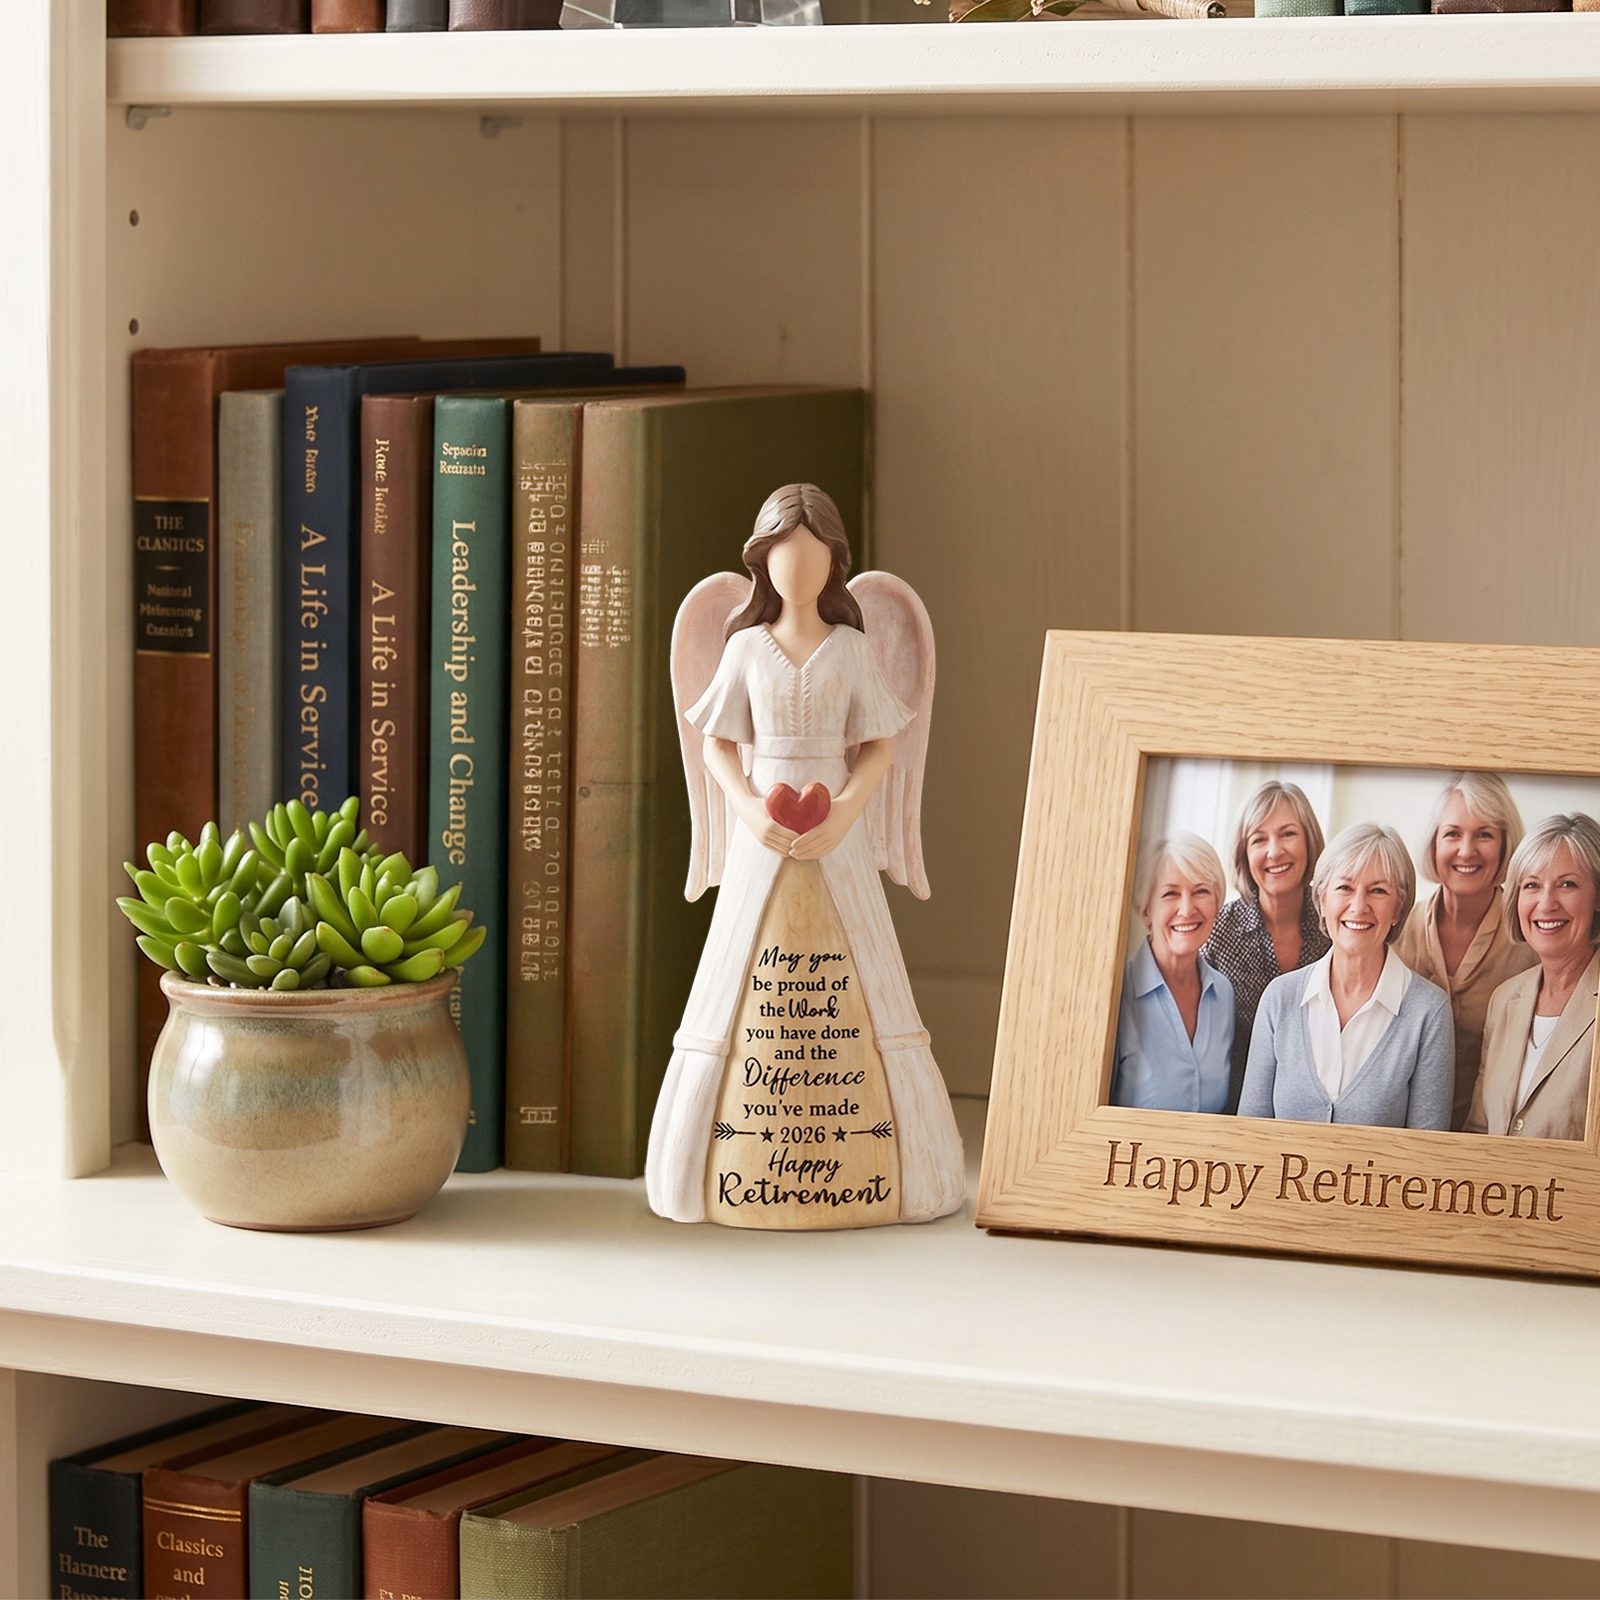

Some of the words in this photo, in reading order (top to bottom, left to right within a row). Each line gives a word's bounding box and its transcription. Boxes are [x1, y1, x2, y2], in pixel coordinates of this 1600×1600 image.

[154, 515, 184, 530] THE
[300, 523, 327, 551] A
[300, 563, 329, 630] Life
[370, 580, 396, 605] A
[443, 520, 477, 683] Leadership
[301, 641, 328, 672] in
[370, 613, 398, 672] Life
[371, 681, 397, 708] in
[450, 691, 476, 744] and
[300, 684, 328, 808] Service
[370, 718, 397, 826] Service
[441, 753, 475, 866] Change
[758, 945, 805, 973] May
[808, 953, 847, 973] you
[752, 976, 773, 992] be
[777, 976, 827, 996] proud
[831, 976, 850, 992] of
[759, 1002, 786, 1018] the
[788, 995, 841, 1019] Work
[746, 1027, 775, 1042] you
[780, 1025, 817, 1040] have
[821, 1025, 861, 1040] done
[774, 1045, 806, 1060] and
[811, 1045, 837, 1060] the
[742, 1057, 867, 1095] Difference
[743, 1100, 803, 1119] you've
[809, 1098, 860, 1116] made
[780, 1126, 827, 1144] 2026
[768, 1147, 843, 1183] Happy
[718, 1172, 892, 1208] Retirement
[1103, 1139, 1264, 1210] Happy
[1275, 1153, 1566, 1223] Retirement
[73, 1525, 110, 1549] The
[156, 1530, 225, 1558] Classics
[173, 1567, 206, 1586] and
